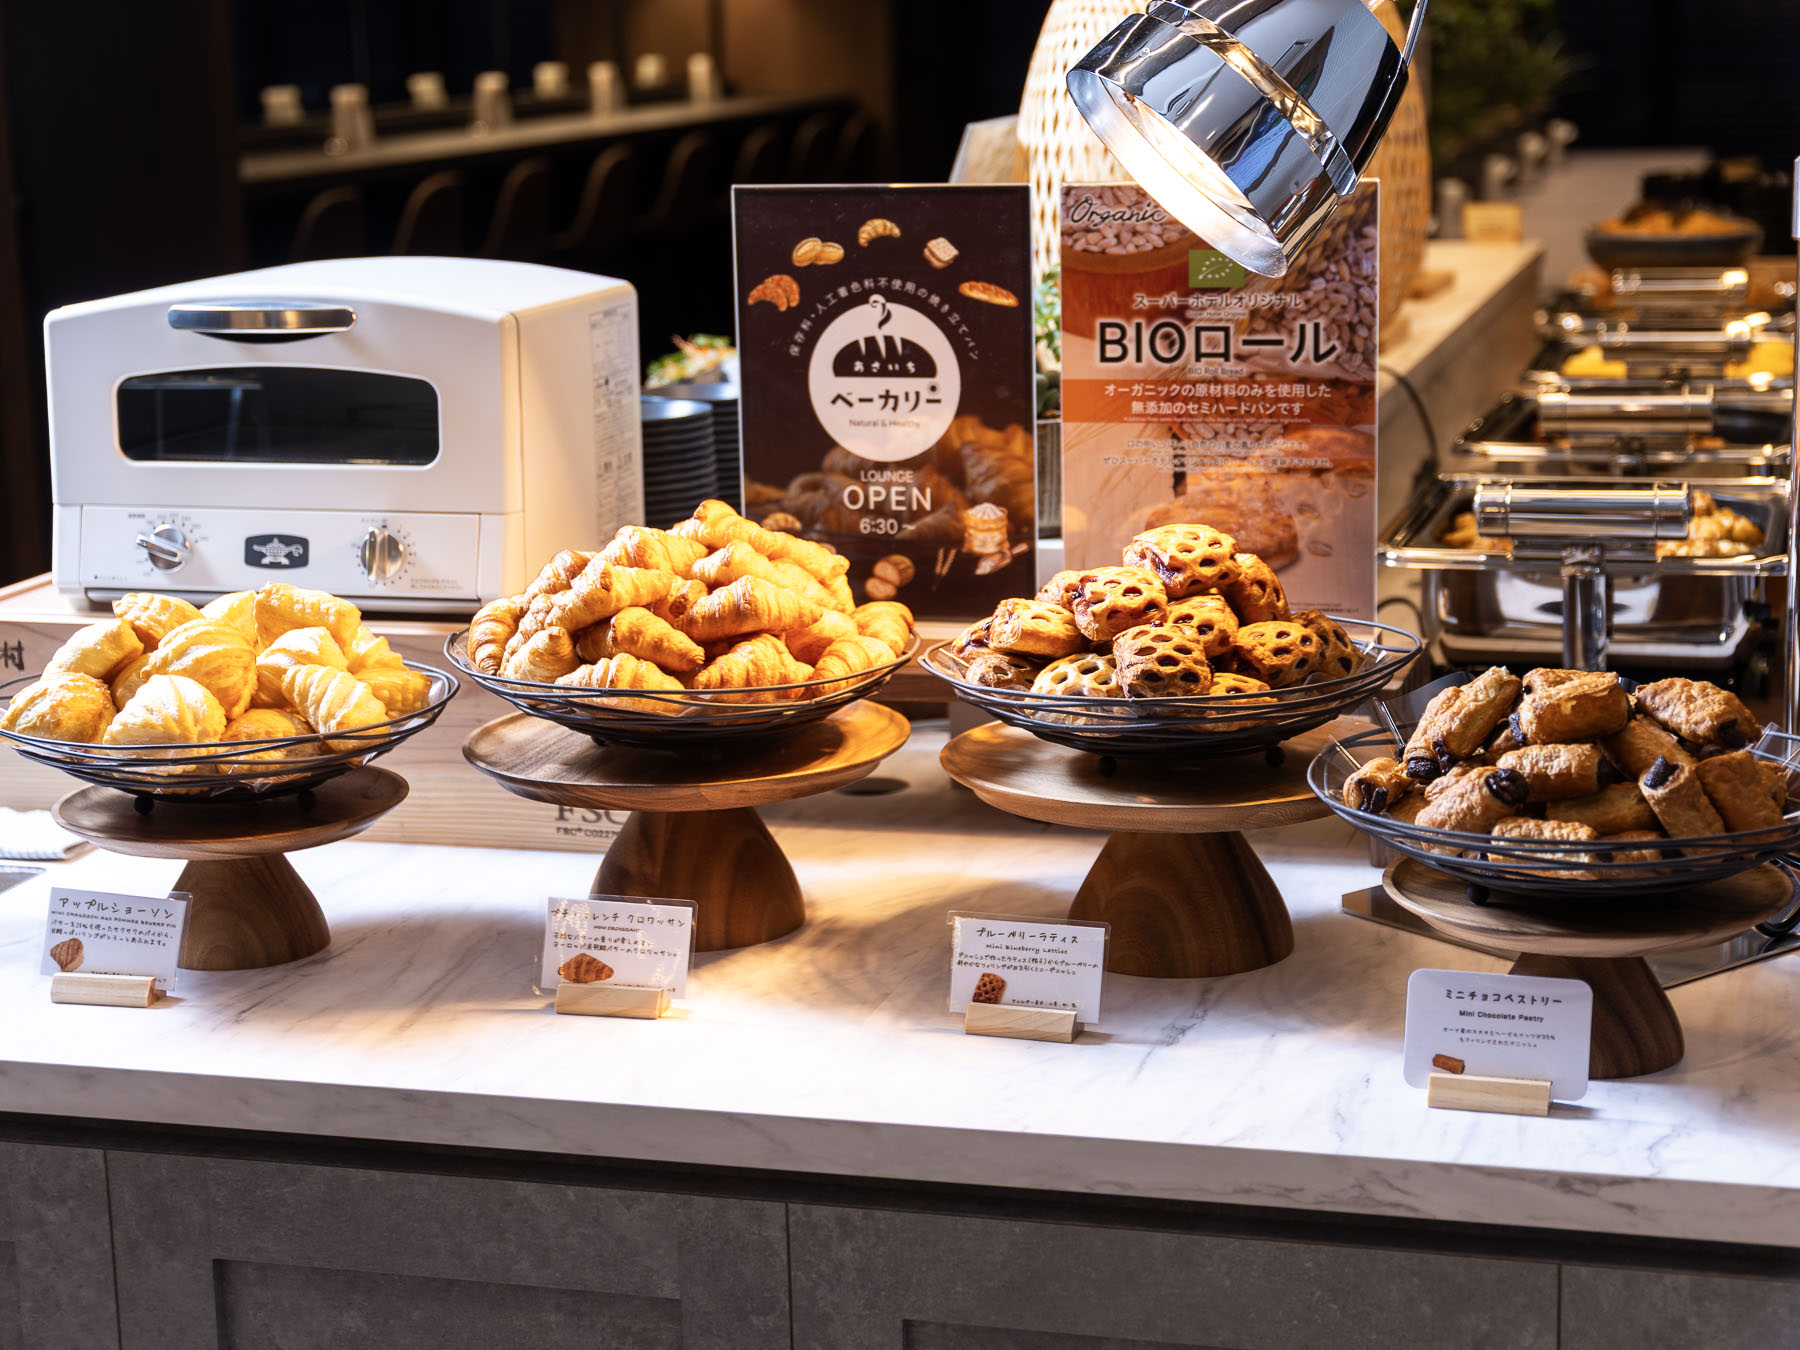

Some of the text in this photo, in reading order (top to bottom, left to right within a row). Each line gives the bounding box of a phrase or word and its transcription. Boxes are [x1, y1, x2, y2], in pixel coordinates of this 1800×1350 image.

[1071, 195, 1167, 227] Organic
[1133, 293, 1302, 310] スーパーホテルオリジナル
[1099, 321, 1337, 364] BIOロール
[853, 360, 916, 374] あさいち
[1221, 368, 1244, 376] Bread
[1104, 383, 1332, 398] オーガニックの原材料のみを使用した
[831, 391, 942, 414] ベーカリー
[1131, 401, 1304, 416] 無添加のセミハードパンです
[849, 419, 878, 427] Natural
[860, 470, 913, 483] LOUNGE
[843, 486, 932, 511] OPEN
[59, 897, 173, 919] アップルショーソン
[627, 914, 686, 927] クロワッサン
[976, 927, 1078, 944] ブルーベリーラティス
[1445, 989, 1563, 1006] ミニチョコペストリー
[1477, 1011, 1516, 1020] Chocolate
[1518, 1014, 1544, 1023] Pastry
